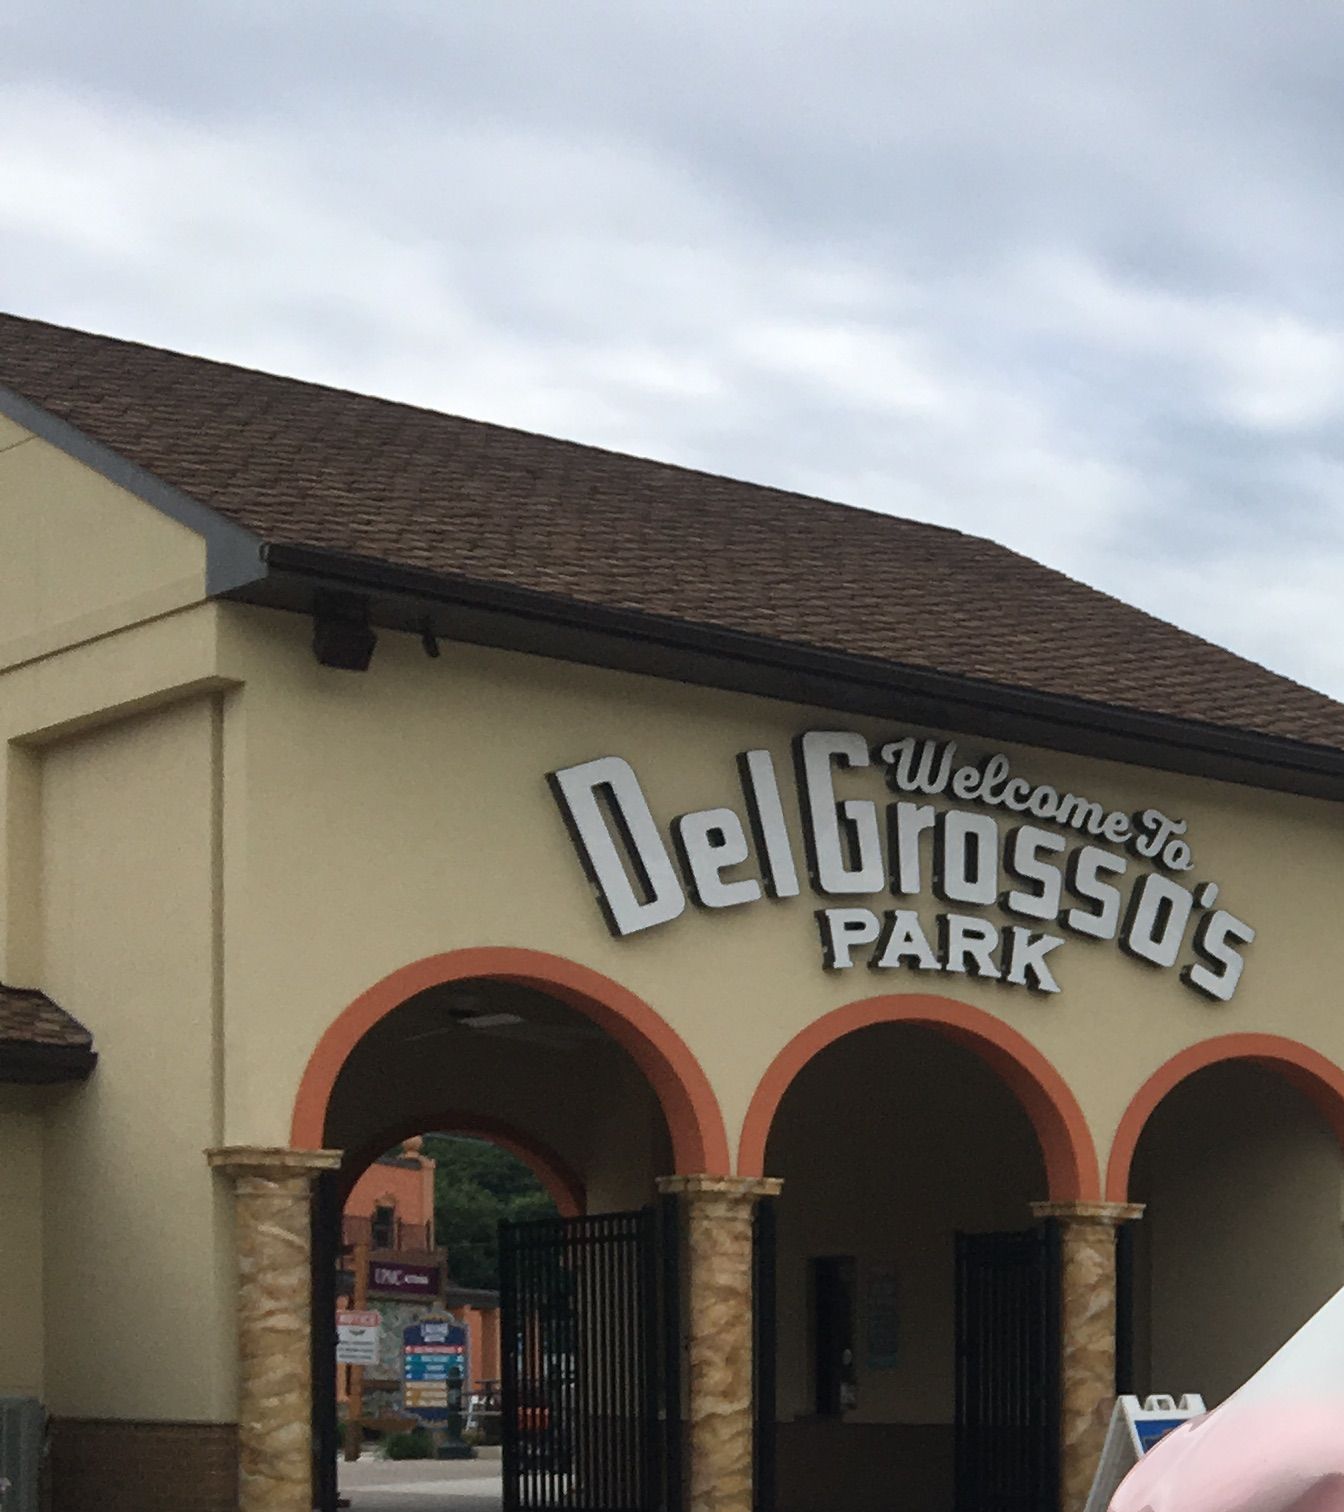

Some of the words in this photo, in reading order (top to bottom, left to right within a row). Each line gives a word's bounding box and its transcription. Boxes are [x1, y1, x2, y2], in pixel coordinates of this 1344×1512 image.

[552, 730, 1255, 1001] DelGrosso's
[881, 736, 1131, 841] Welcome
[1137, 809, 1194, 871] To
[822, 908, 1066, 993] PARK
